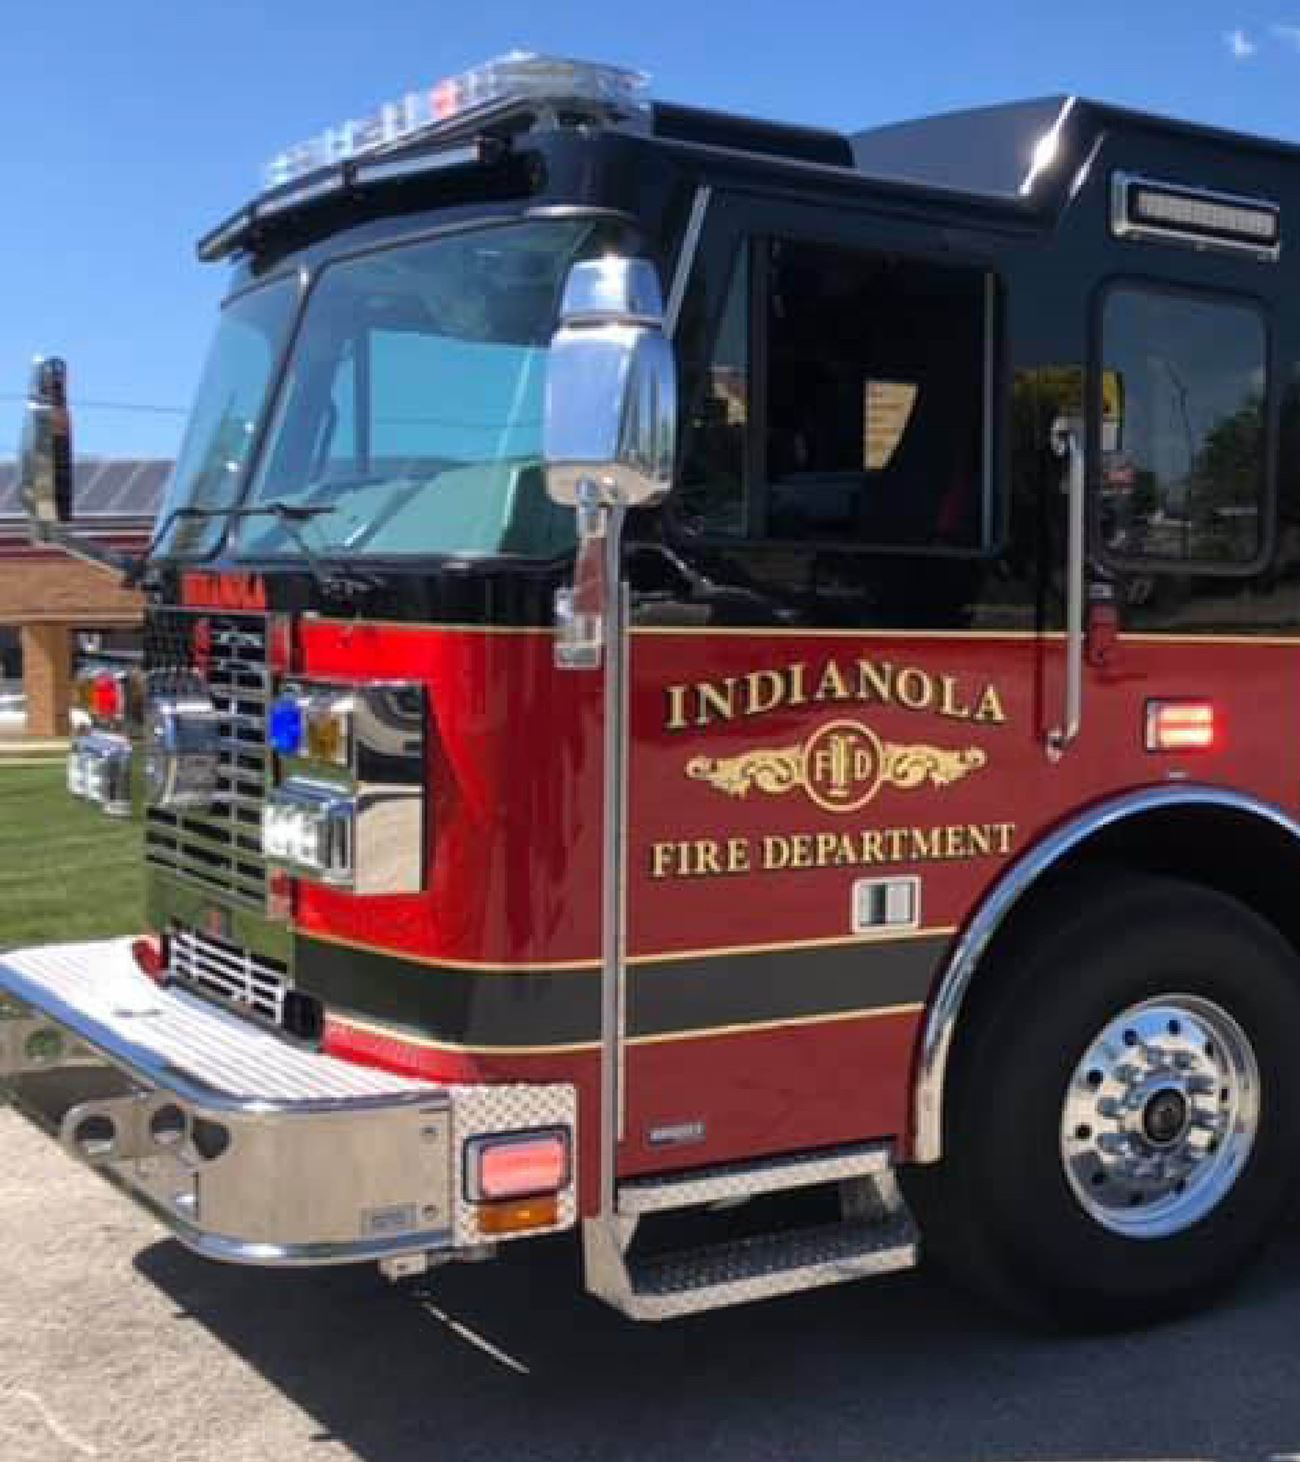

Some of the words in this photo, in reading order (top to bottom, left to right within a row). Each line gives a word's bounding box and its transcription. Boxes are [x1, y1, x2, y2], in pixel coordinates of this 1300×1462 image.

[665, 660, 1006, 729] INDIANOLA
[652, 839, 750, 878] FIRE
[763, 824, 1014, 869] DEPARTMENT
